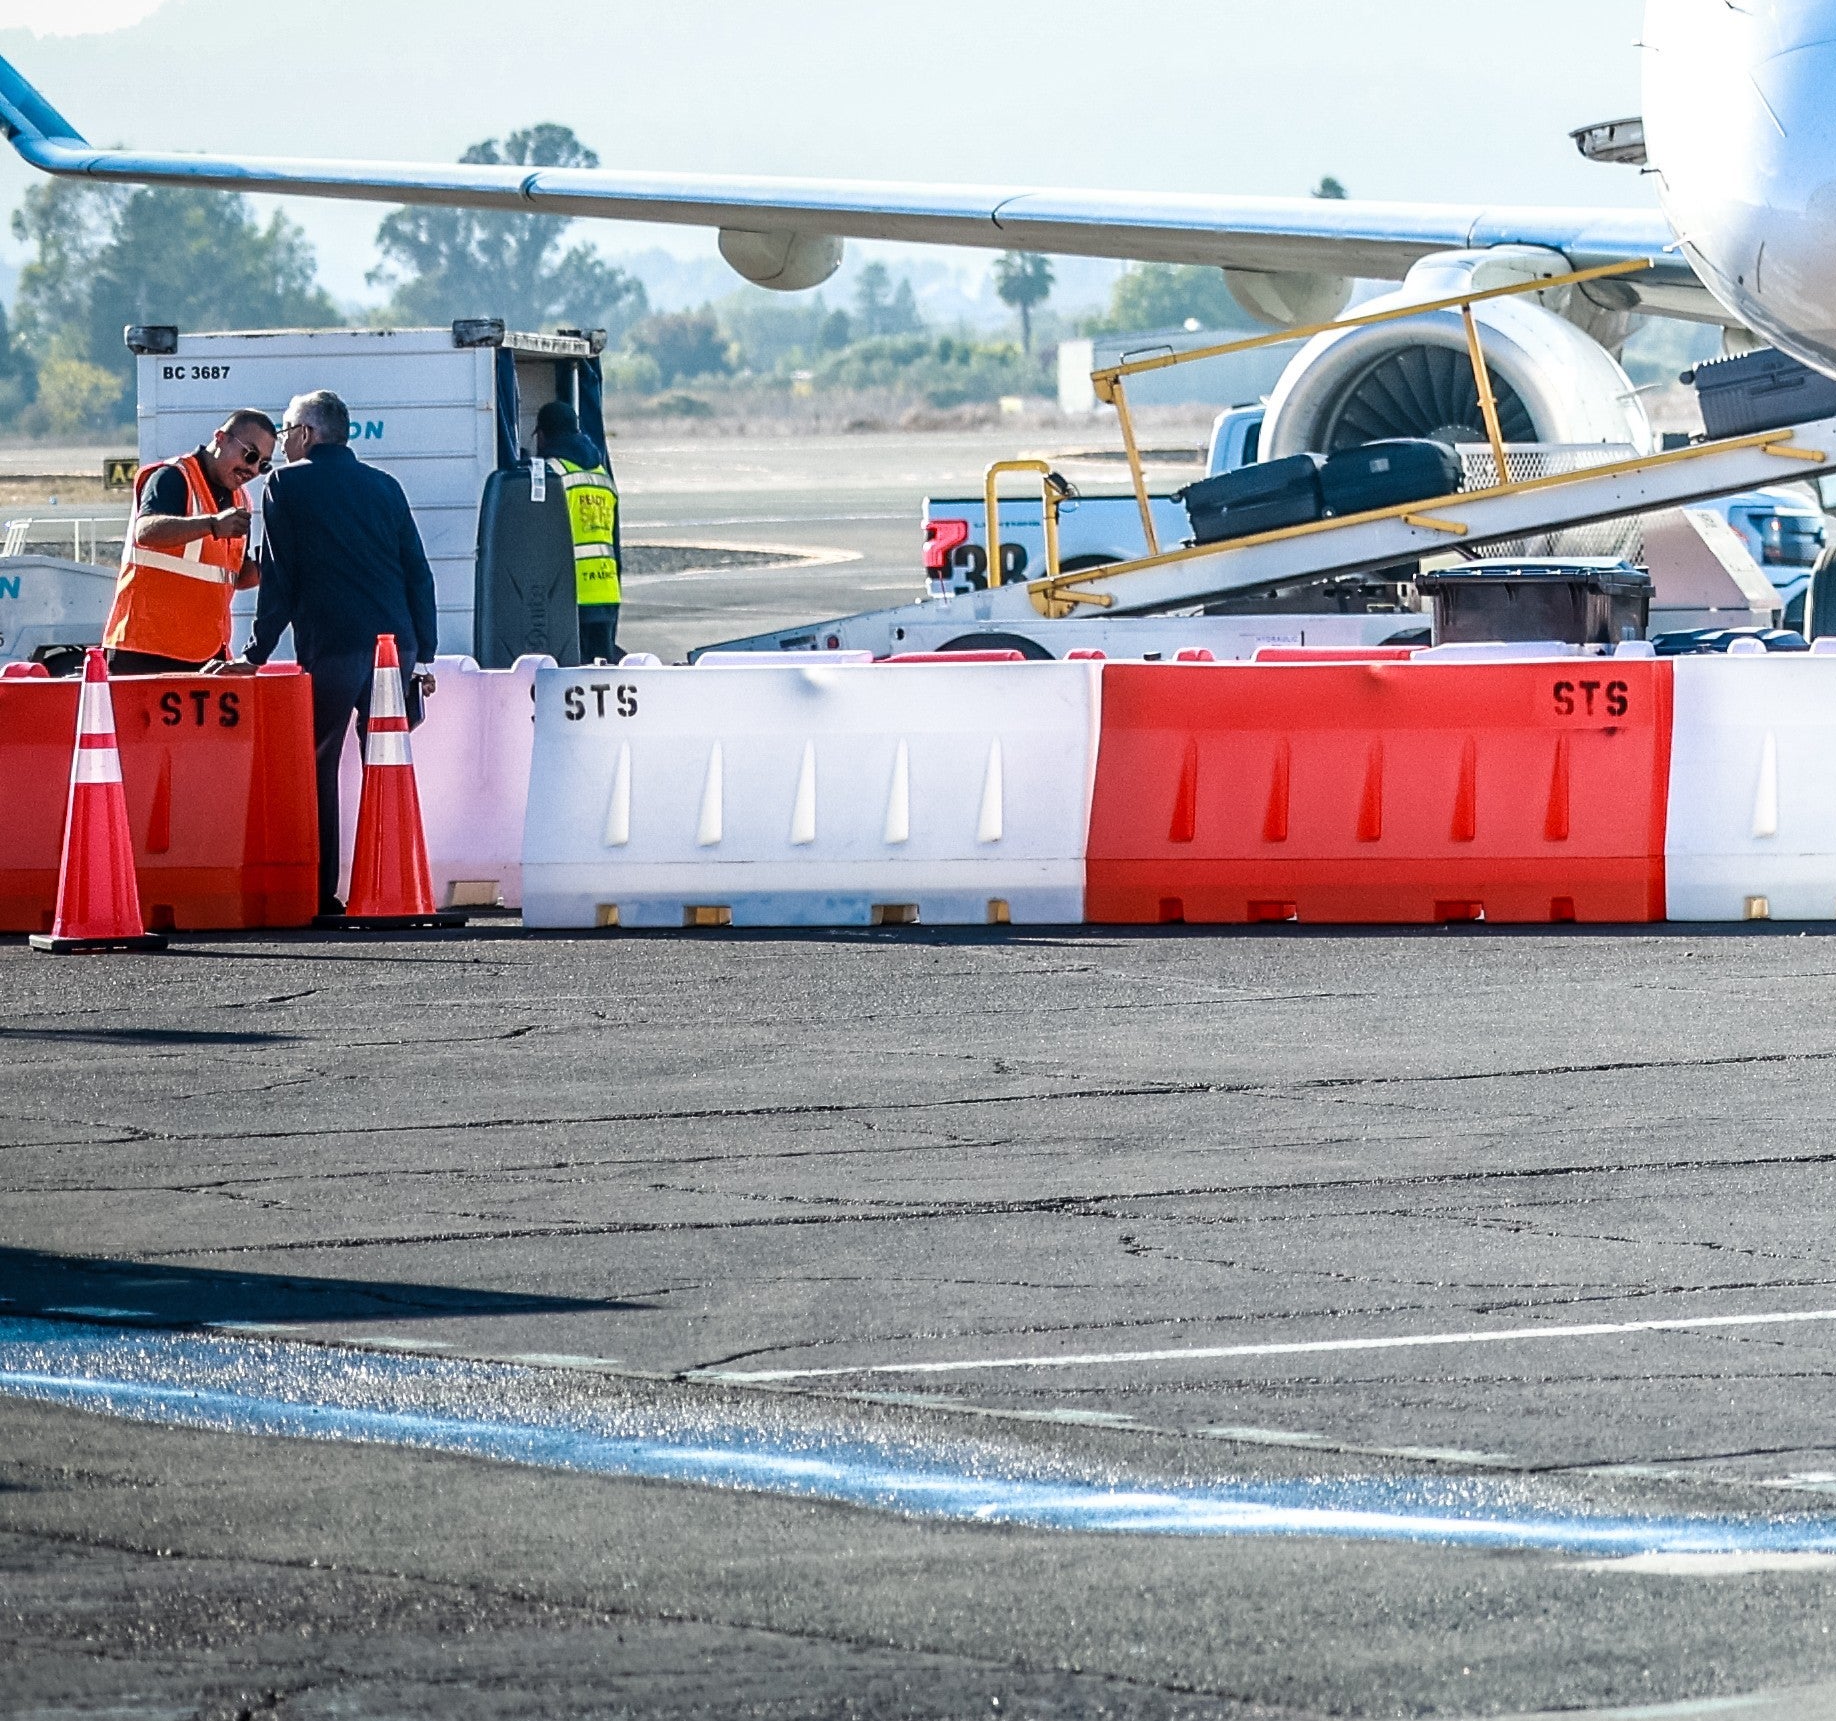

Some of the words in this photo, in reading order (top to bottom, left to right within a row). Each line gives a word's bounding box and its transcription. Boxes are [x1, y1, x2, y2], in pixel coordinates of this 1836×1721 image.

[162, 366, 186, 380] BC
[191, 366, 231, 380] 3687
[160, 691, 241, 728] STS
[564, 684, 639, 720] STS
[1553, 680, 1629, 717] STS
